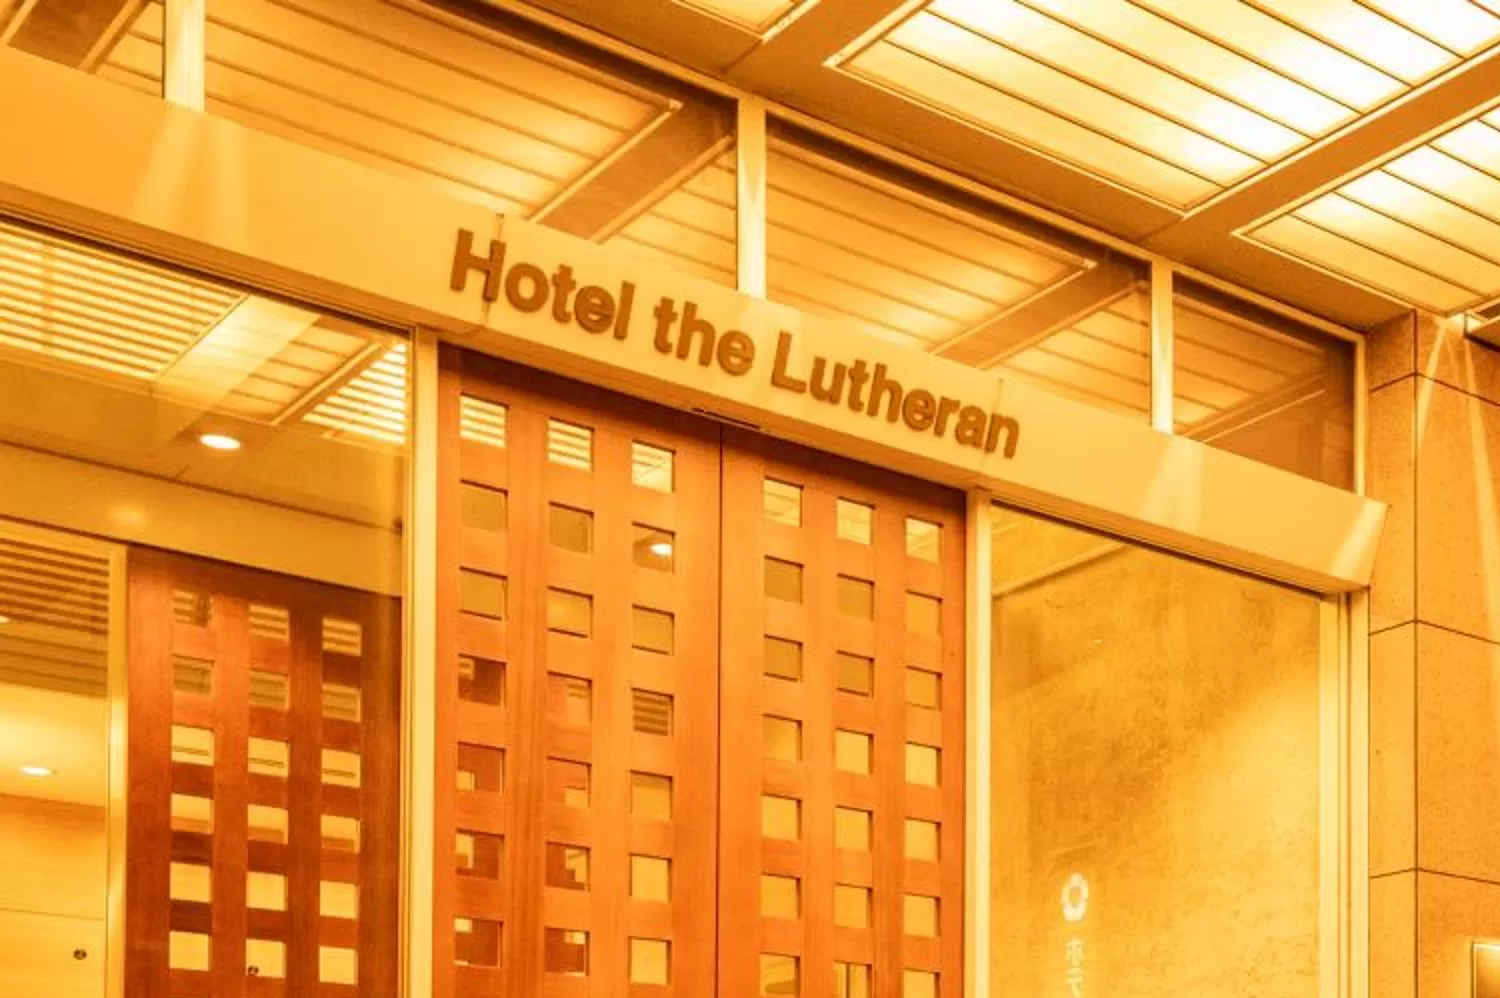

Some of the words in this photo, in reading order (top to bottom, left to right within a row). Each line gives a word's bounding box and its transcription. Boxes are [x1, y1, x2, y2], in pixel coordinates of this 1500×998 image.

[450, 228, 635, 341] Hotel
[654, 295, 755, 377] the
[771, 330, 1020, 459] Lutheran
